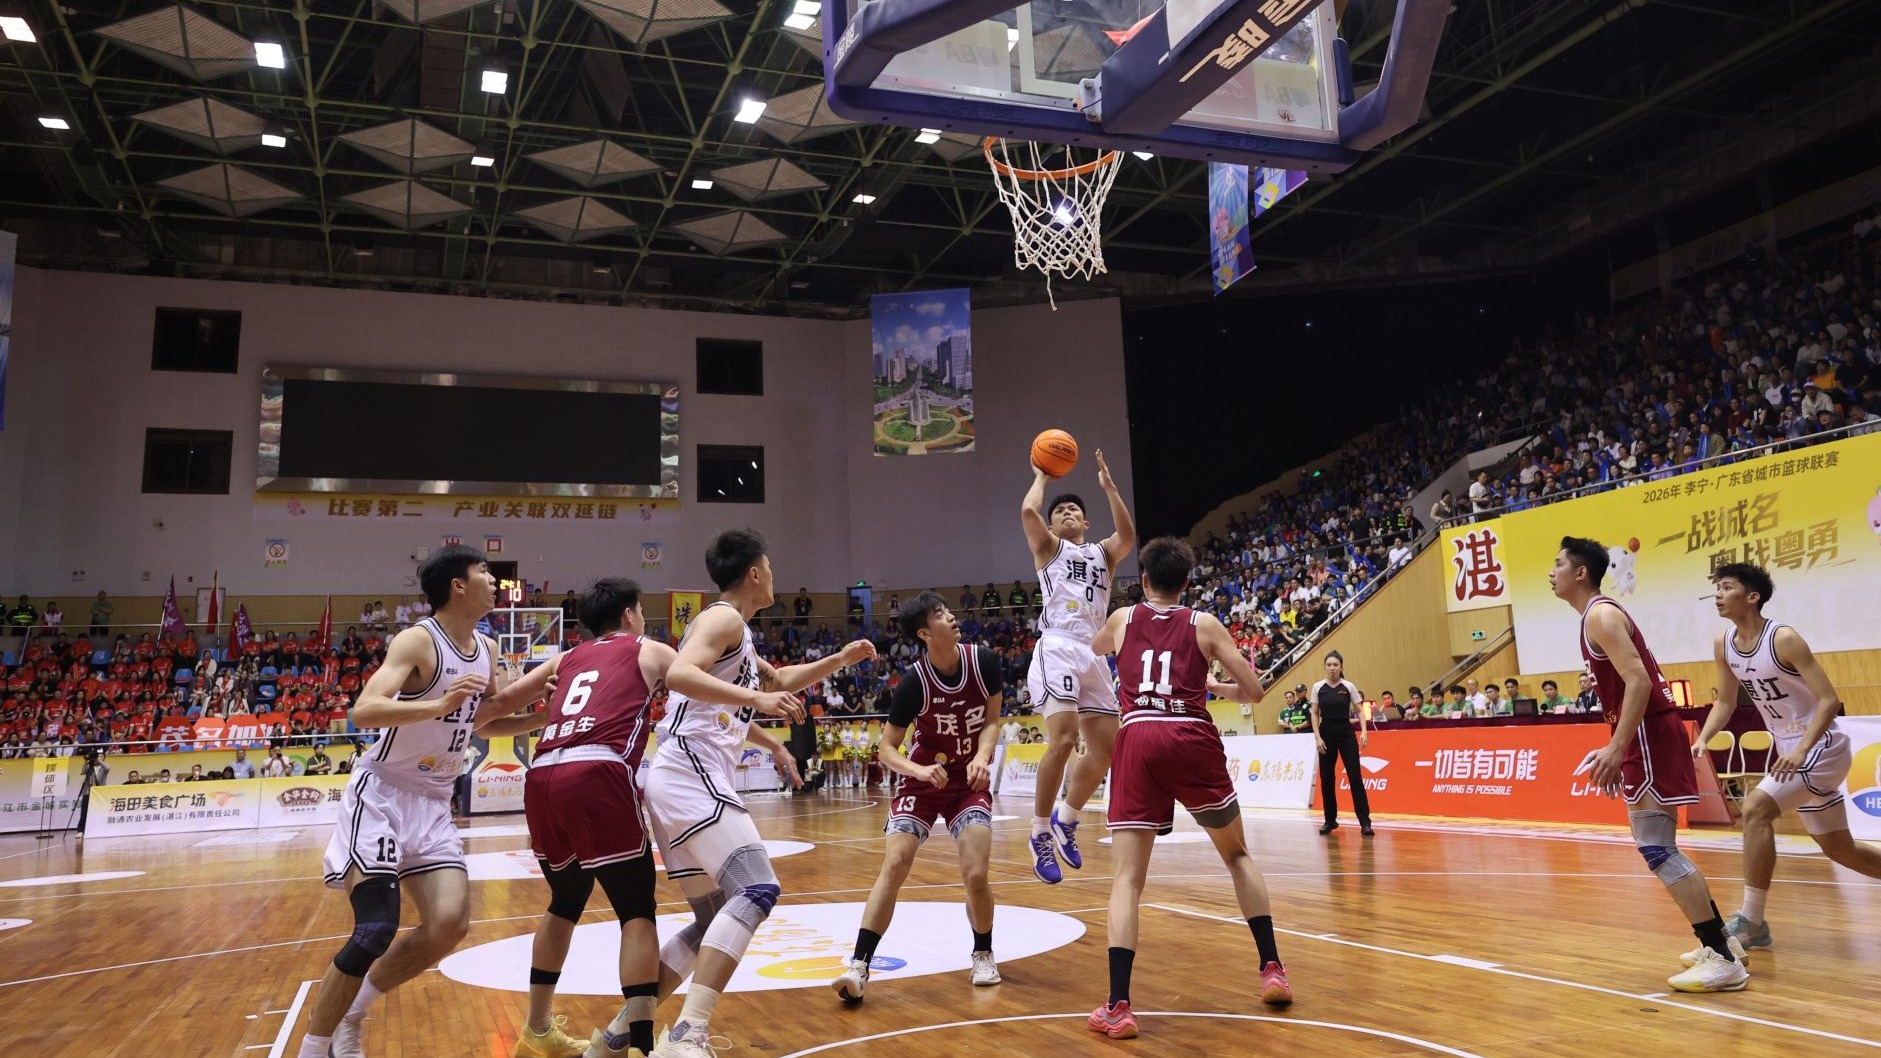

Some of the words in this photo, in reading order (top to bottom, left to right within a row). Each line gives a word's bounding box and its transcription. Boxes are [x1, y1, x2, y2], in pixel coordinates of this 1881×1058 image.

[1643, 484, 1682, 504] 2026年
[1684, 450, 1840, 497] 李宁·广东省城市篮球联赛
[328, 499, 424, 517] 比赛第二
[453, 500, 618, 520] 产业关联双延链
[1654, 489, 1784, 555] 一战城名
[1066, 559, 1108, 591] 湛江
[1453, 529, 1505, 601] 湛
[509, 588, 522, 602] 10
[1086, 586, 1094, 602] 0
[1063, 675, 1073, 692] 0
[1138, 649, 1173, 696] 11
[560, 670, 600, 716] 6
[933, 704, 986, 736] 茂名
[448, 728, 467, 752] 12
[955, 737, 972, 756] 13
[1414, 748, 1539, 781] 一切皆有可能
[1340, 777, 1388, 792] LING
[1432, 783, 1466, 795] ANYTHING
[1466, 785, 1473, 795] IS
[1475, 784, 1513, 796] POSSIBLE
[108, 793, 207, 813] 海田美食广场
[896, 795, 917, 812] 13
[106, 808, 241, 825] 融通农业发展(湛江)有限责任公司
[376, 836, 398, 864] 12
